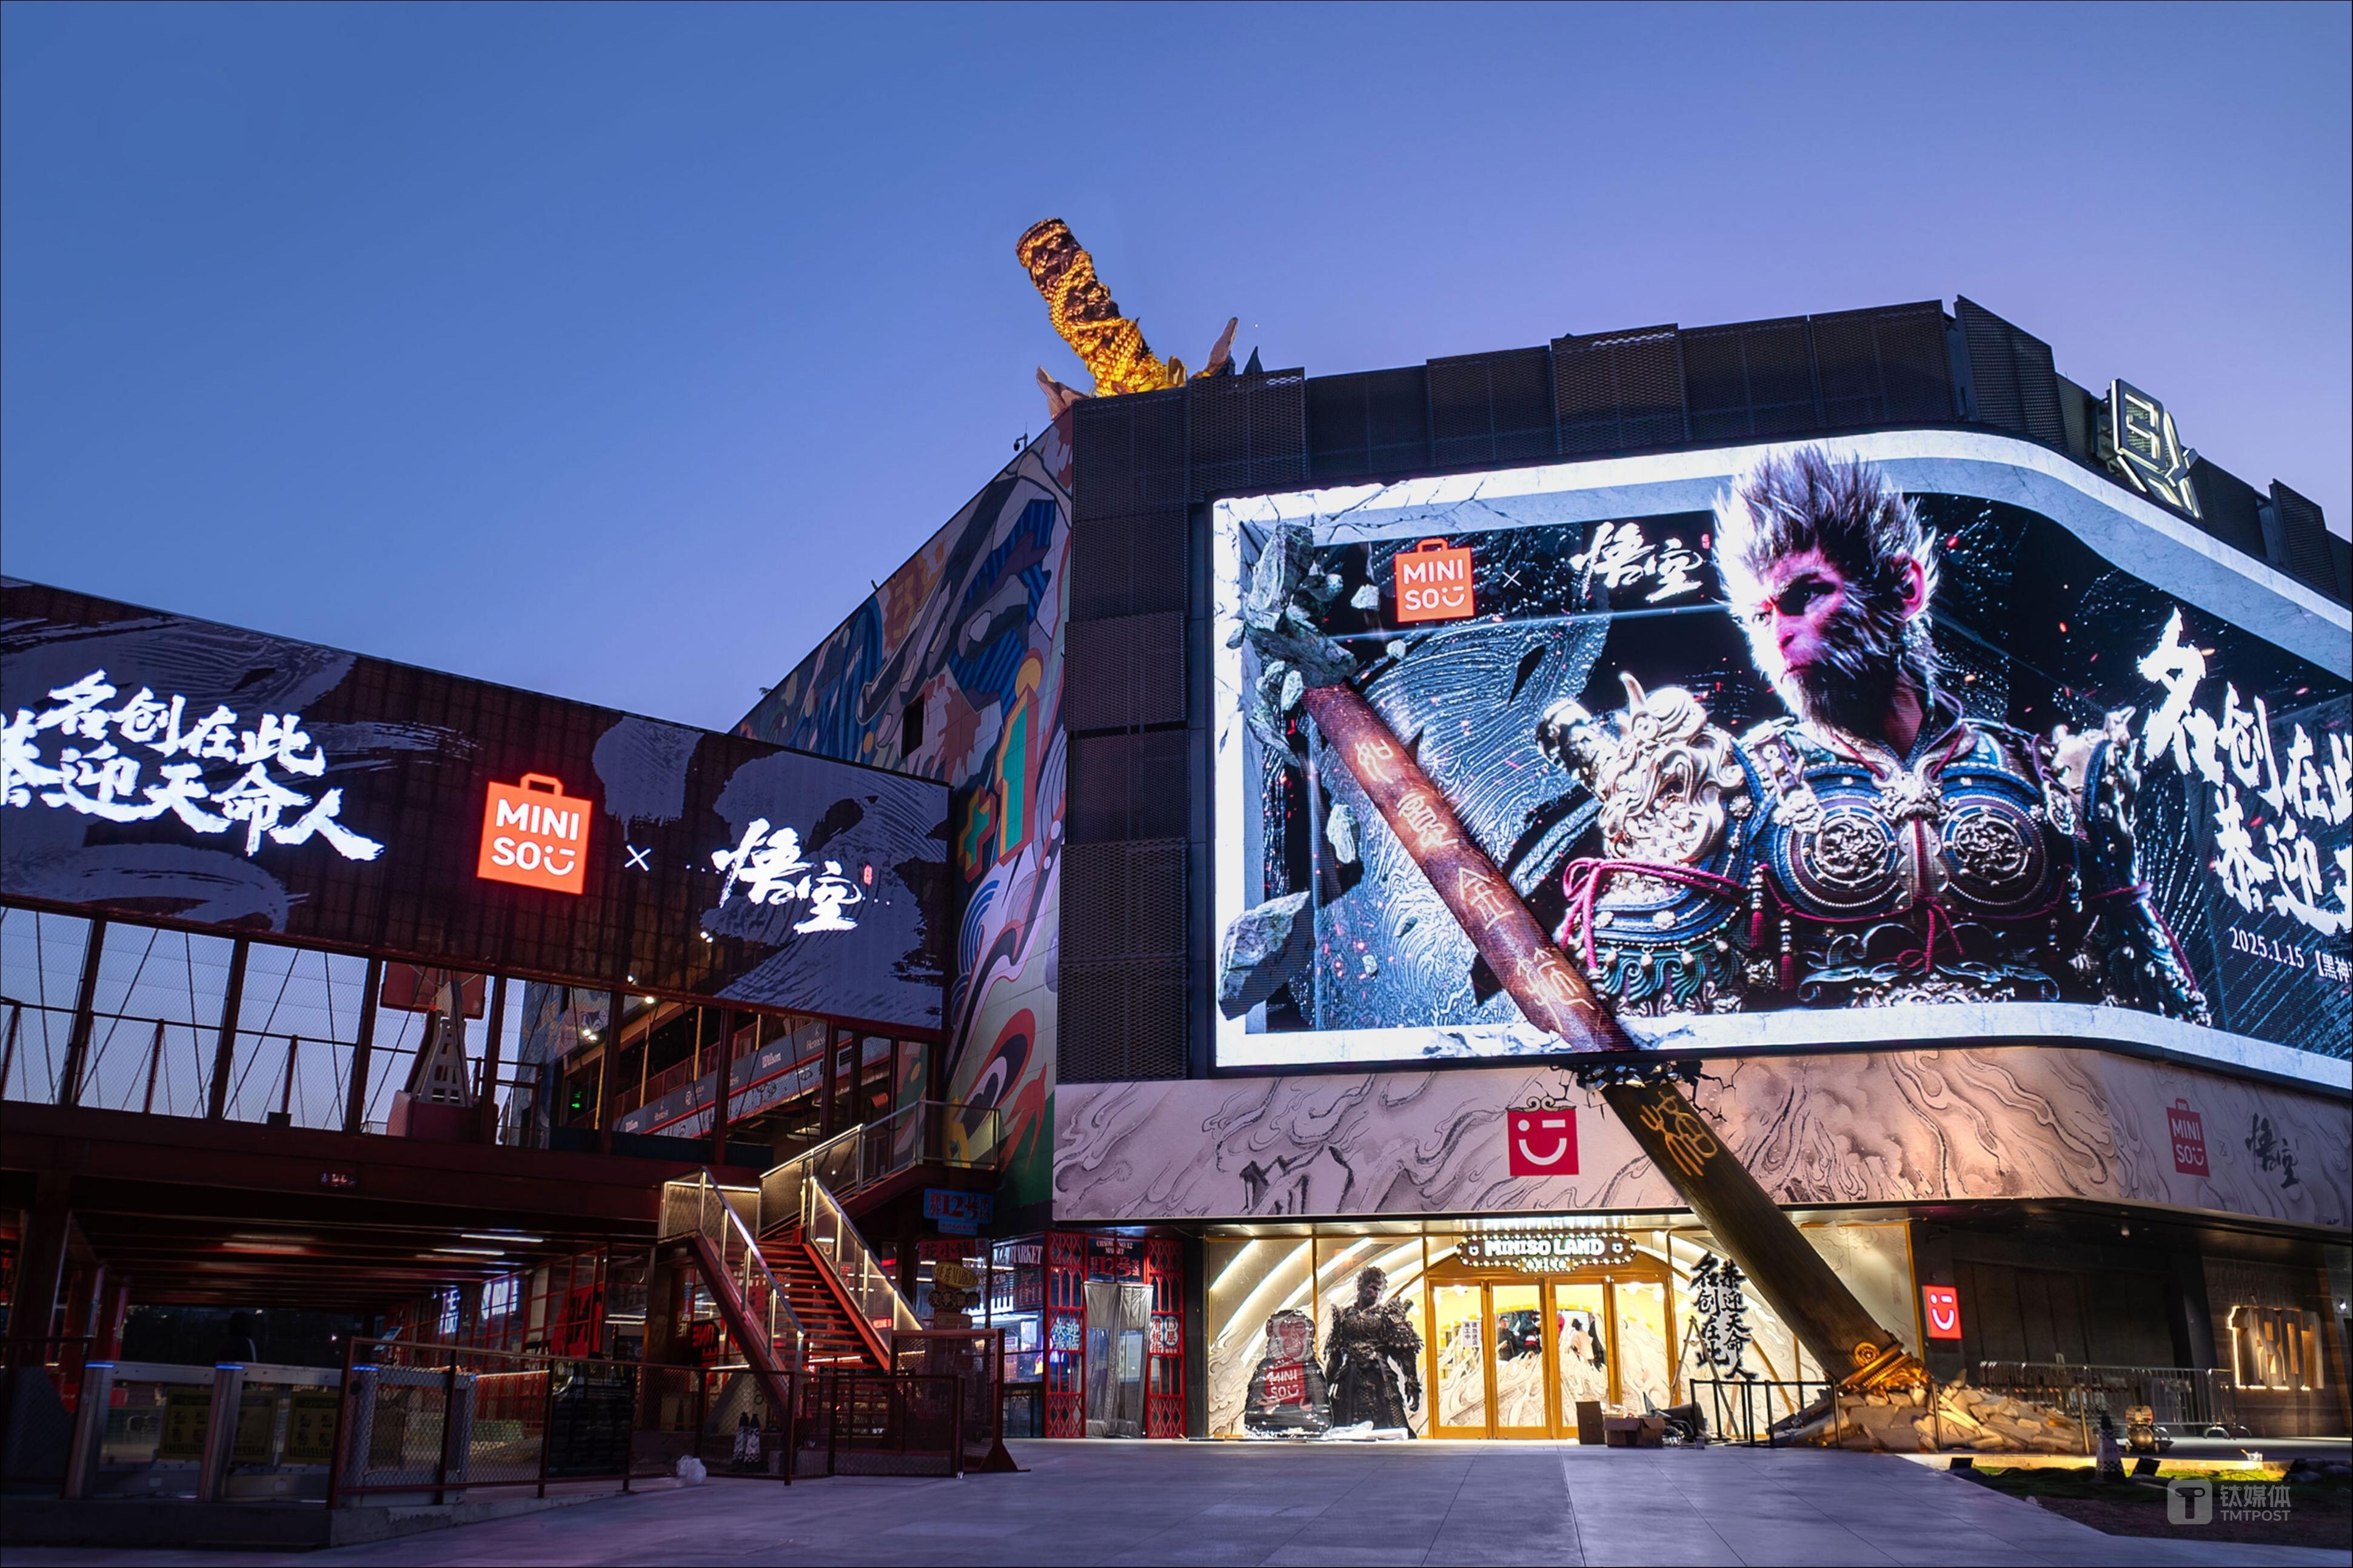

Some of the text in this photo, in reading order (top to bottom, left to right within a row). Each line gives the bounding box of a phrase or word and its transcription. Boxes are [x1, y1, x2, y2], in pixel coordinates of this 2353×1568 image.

[1404, 558, 1464, 585] MINI
[1569, 521, 1702, 603] 悟空
[38, 668, 327, 777] 名创在此
[495, 799, 580, 841] MINI
[712, 818, 862, 934] 悟空
[2213, 783, 2352, 936] 恭迎
[2229, 926, 2305, 968] 2025.1.15
[2315, 950, 2352, 983] 【黑神
[2171, 1117, 2200, 1141] MINI
[2244, 1112, 2300, 1189] 悟空
[1009, 1245, 1043, 1265] MARKET
[1485, 1238, 1605, 1256] MINISO LAND
[1689, 1250, 1730, 1367] 名创在此
[1719, 1258, 1759, 1380] 恭迎天命人
